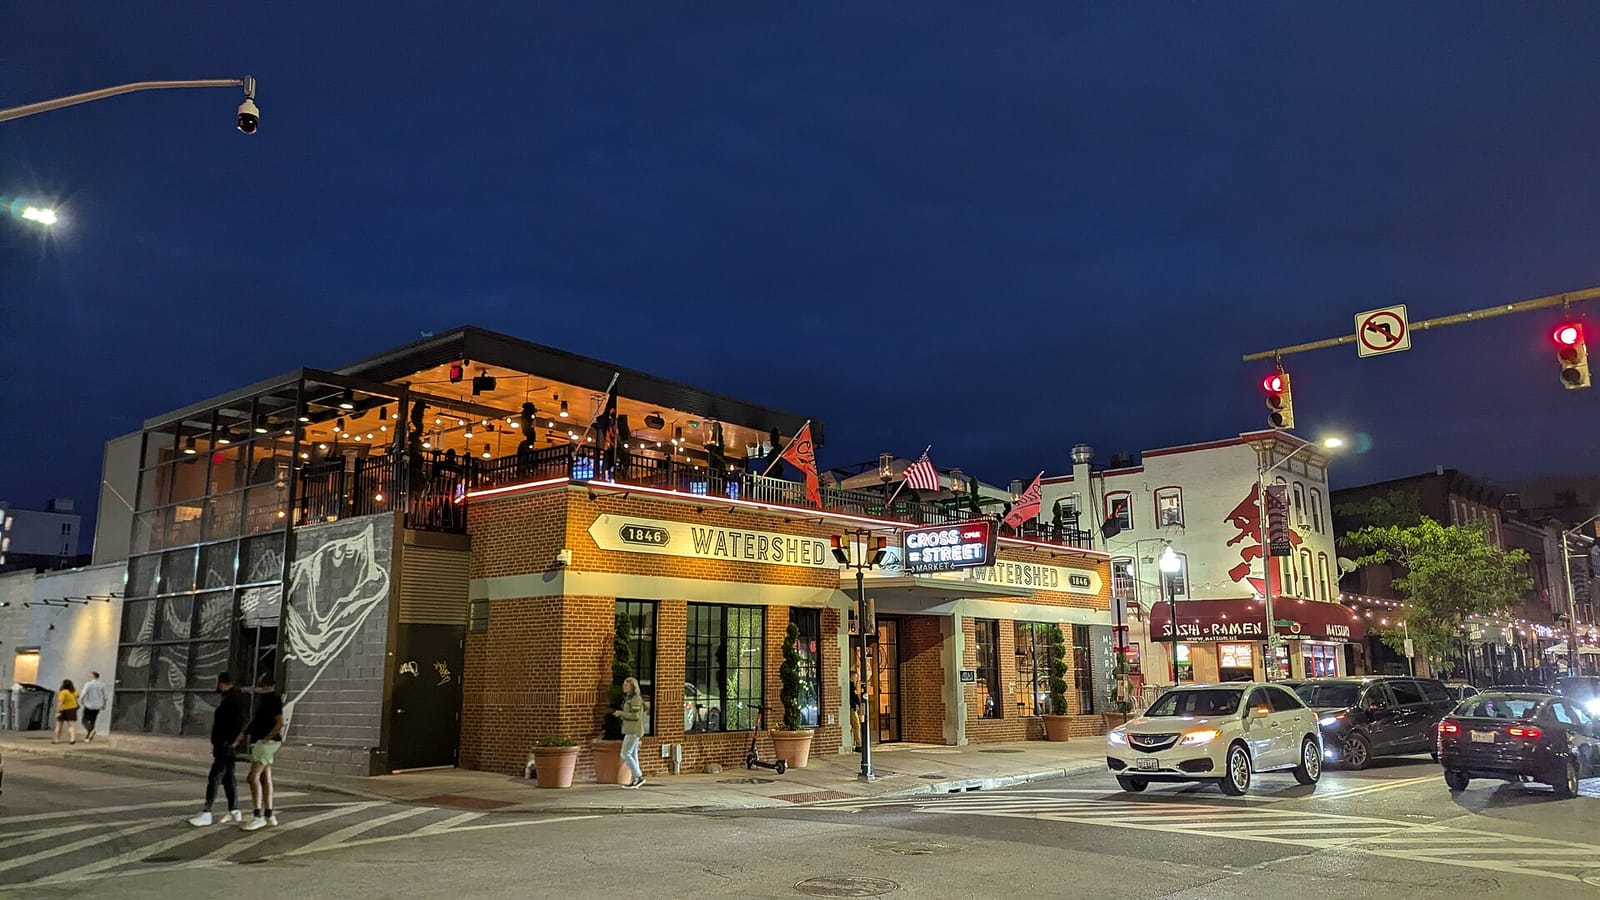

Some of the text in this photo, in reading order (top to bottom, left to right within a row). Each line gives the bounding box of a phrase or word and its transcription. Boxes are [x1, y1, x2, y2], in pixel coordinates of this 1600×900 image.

[628, 529, 661, 542] 1846
[906, 530, 960, 548] CROSS
[691, 527, 826, 565] WATERSHED
[922, 543, 983, 562] STREET
[916, 562, 949, 573] MARKET
[972, 562, 1059, 588] WATERSHED
[1072, 577, 1088, 586] 1846
[1211, 622, 1263, 635] RAMEN
[1102, 635, 1112, 704] MARKET
